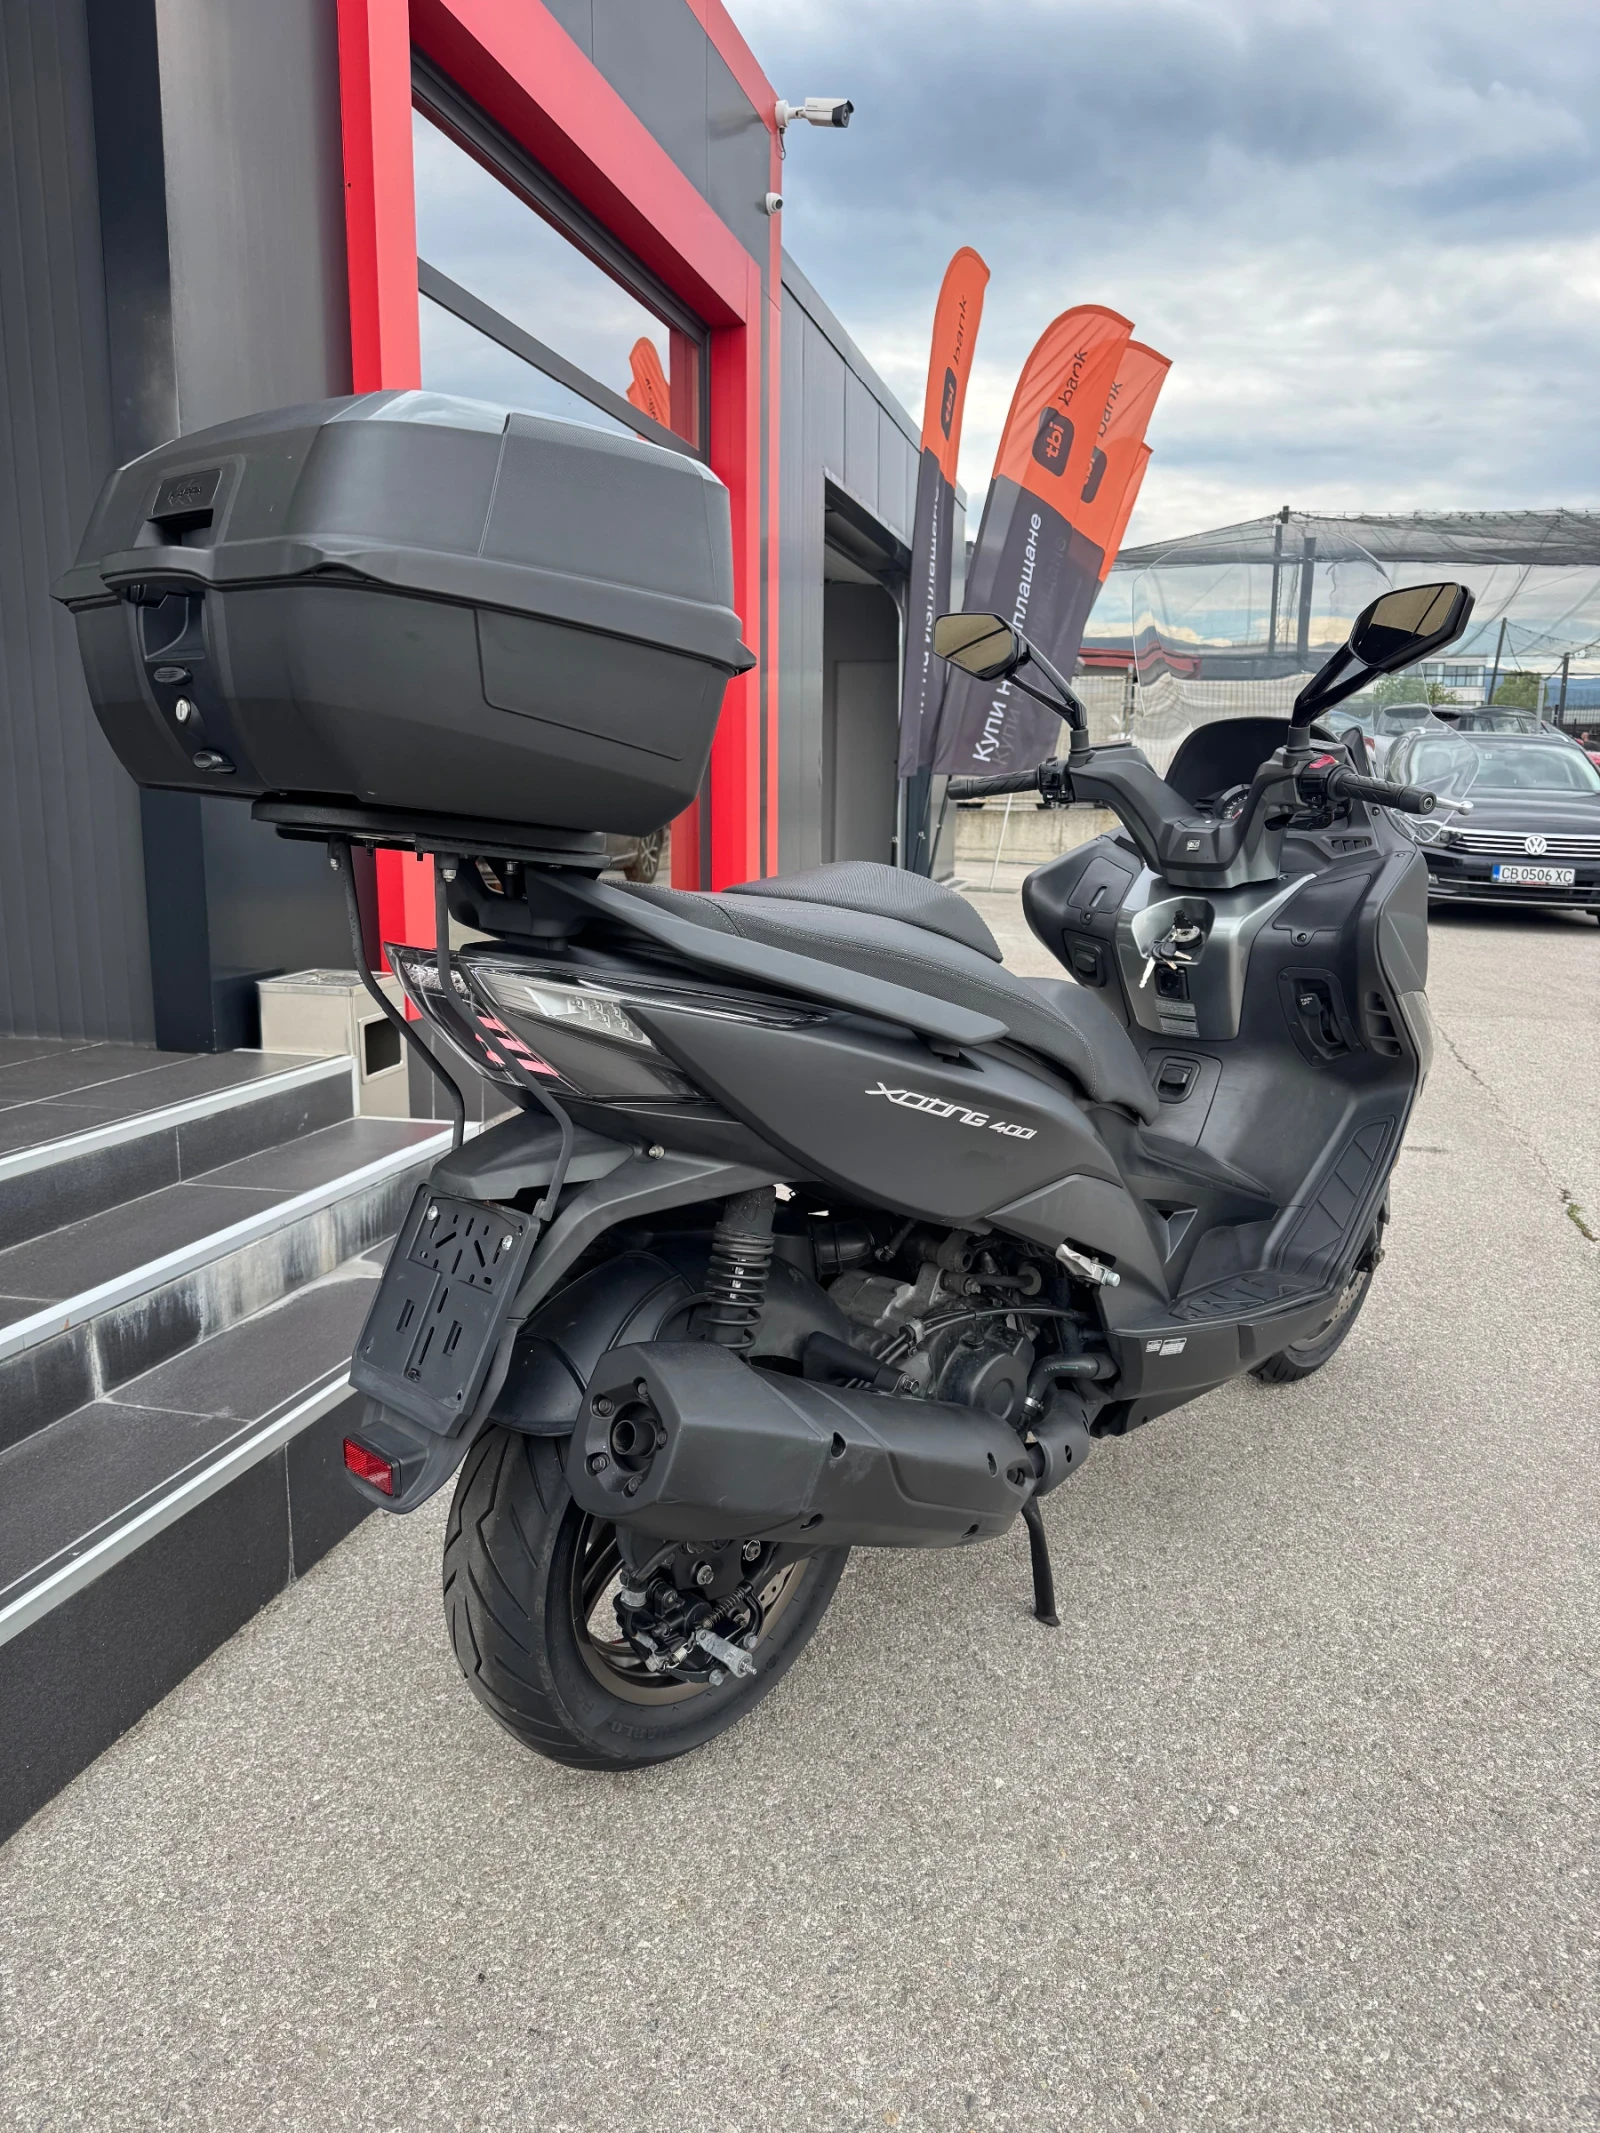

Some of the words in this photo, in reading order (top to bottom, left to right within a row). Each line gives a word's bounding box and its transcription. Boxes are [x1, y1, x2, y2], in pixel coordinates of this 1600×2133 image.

[953, 295, 968, 366] bank
[1046, 421, 1065, 459] tbi
[1058, 347, 1088, 408] bank
[972, 701, 1007, 763] Купи
[996, 680, 1012, 696] н
[1012, 513, 1042, 636] плащане
[1501, 867, 1519, 880] CB
[1521, 868, 1553, 881] 0506
[1555, 870, 1573, 882] XC
[988, 1121, 1038, 1140] 400i
